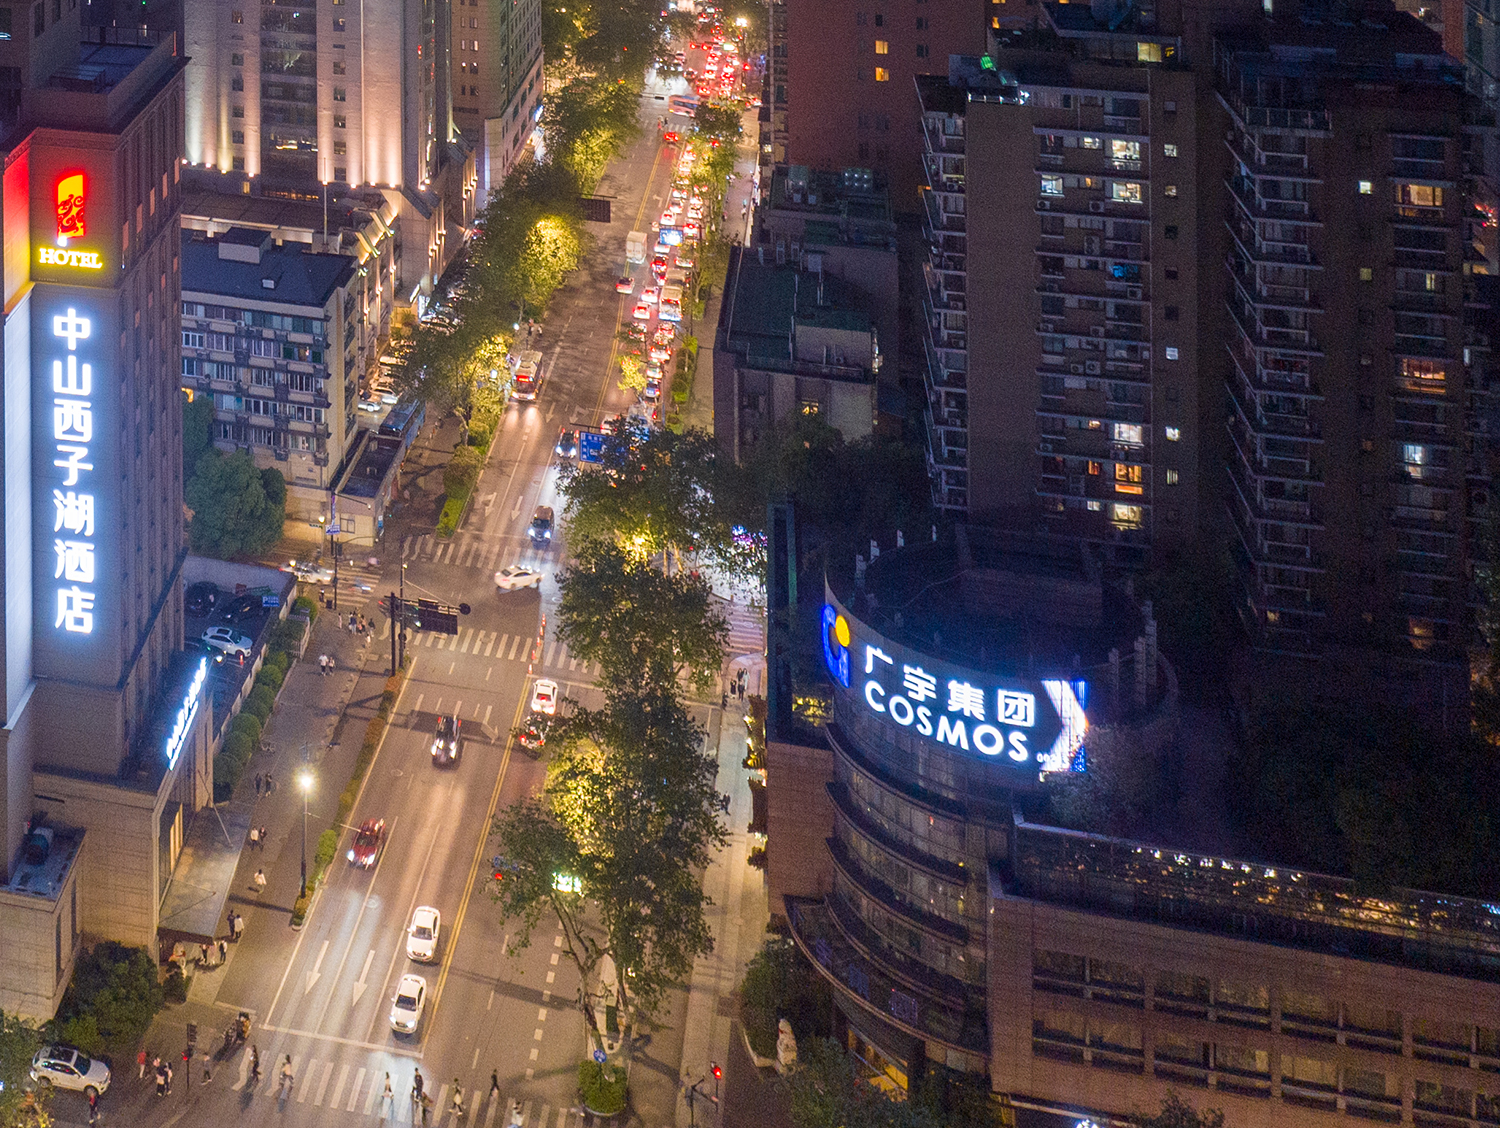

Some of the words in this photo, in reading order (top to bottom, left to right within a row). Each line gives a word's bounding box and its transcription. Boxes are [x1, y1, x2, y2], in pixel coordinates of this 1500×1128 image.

[39, 247, 103, 269] HOTEL
[53, 308, 95, 633] 中山西子湖酒店
[864, 645, 1035, 728] 广宇集团
[864, 680, 1029, 762] COSMOS
